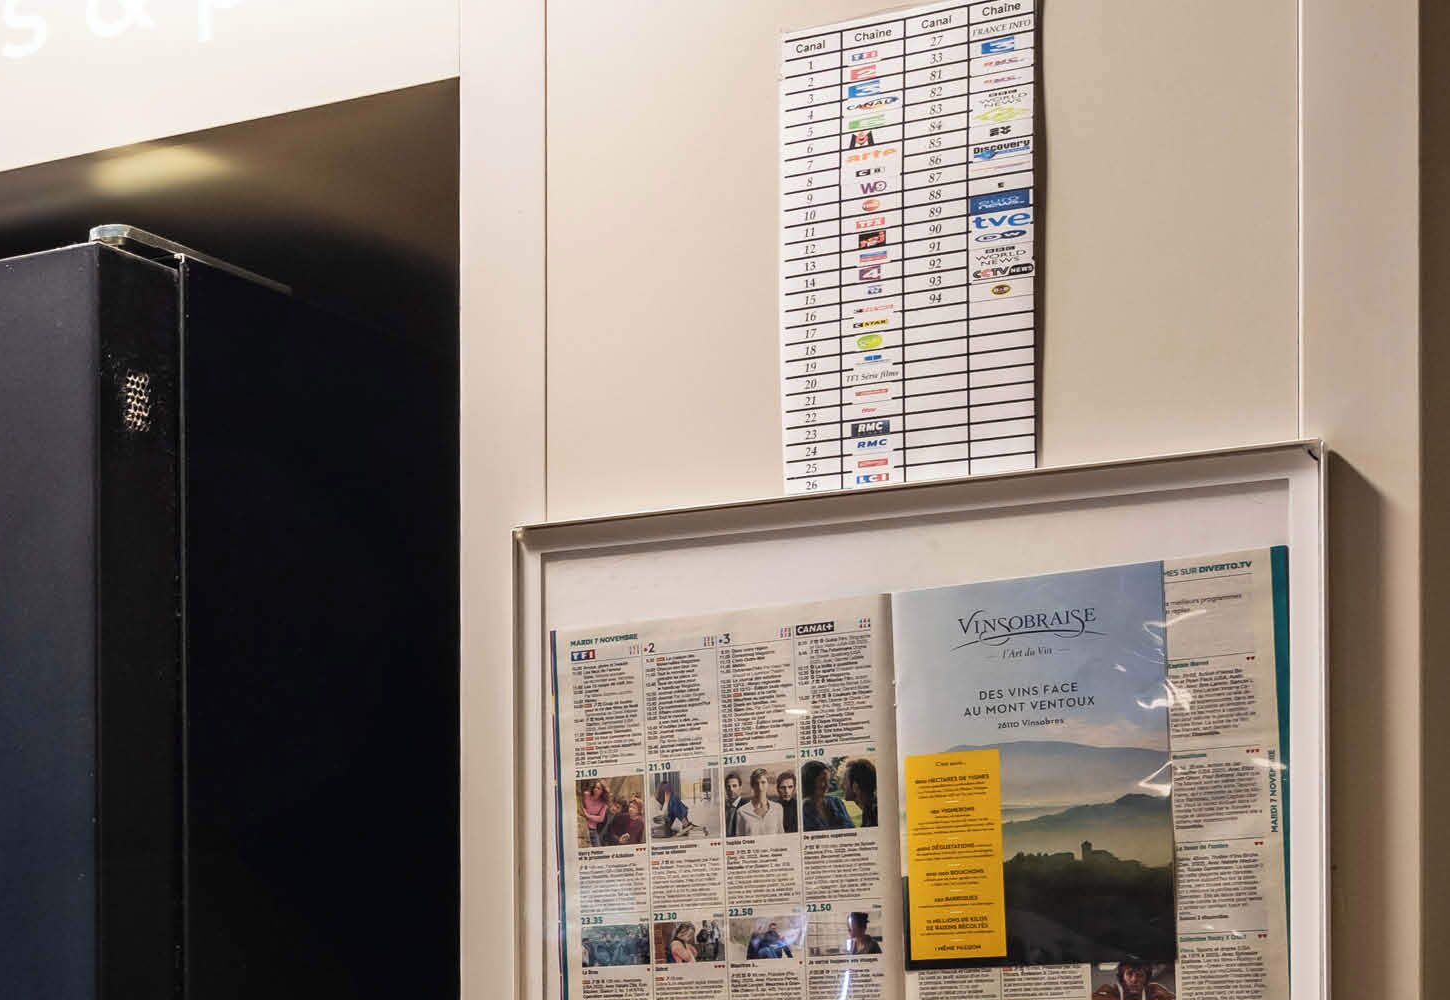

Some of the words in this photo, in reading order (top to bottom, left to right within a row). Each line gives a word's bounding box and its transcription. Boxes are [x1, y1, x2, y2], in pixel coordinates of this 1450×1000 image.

[921, 15, 951, 28] Canal
[972, 23, 1006, 37] FRANCE
[796, 40, 825, 52] Canal
[930, 35, 943, 47] 27
[930, 69, 943, 81] 81
[973, 140, 1030, 154] Discovery
[928, 189, 942, 201] 88
[972, 212, 1031, 230] tve
[929, 293, 942, 305] 94
[858, 422, 883, 433] RMC
[857, 439, 887, 449] RMC
[806, 479, 818, 491] 26
[1181, 568, 1197, 576] SUR
[1198, 561, 1252, 573] DIVERTO.TV
[796, 622, 834, 634] CANAL+
[570, 638, 594, 647] MARDI
[599, 633, 638, 643] NOVEMBRE
[1025, 648, 1036, 658] du
[1037, 646, 1053, 658] Vin
[979, 687, 1003, 700] DES
[1007, 684, 1039, 698] VINS
[1043, 681, 1079, 697] FACE
[963, 704, 982, 718] AU
[985, 700, 1025, 716] MONT
[1030, 695, 1096, 711] VENTOUX
[997, 720, 1020, 730] 26110
[1022, 716, 1064, 728] Vinsobres
[801, 748, 824, 758] 21.10
[648, 761, 671, 772] 21.10
[806, 903, 831, 914] 22.50
[654, 911, 677, 922] 22.30
